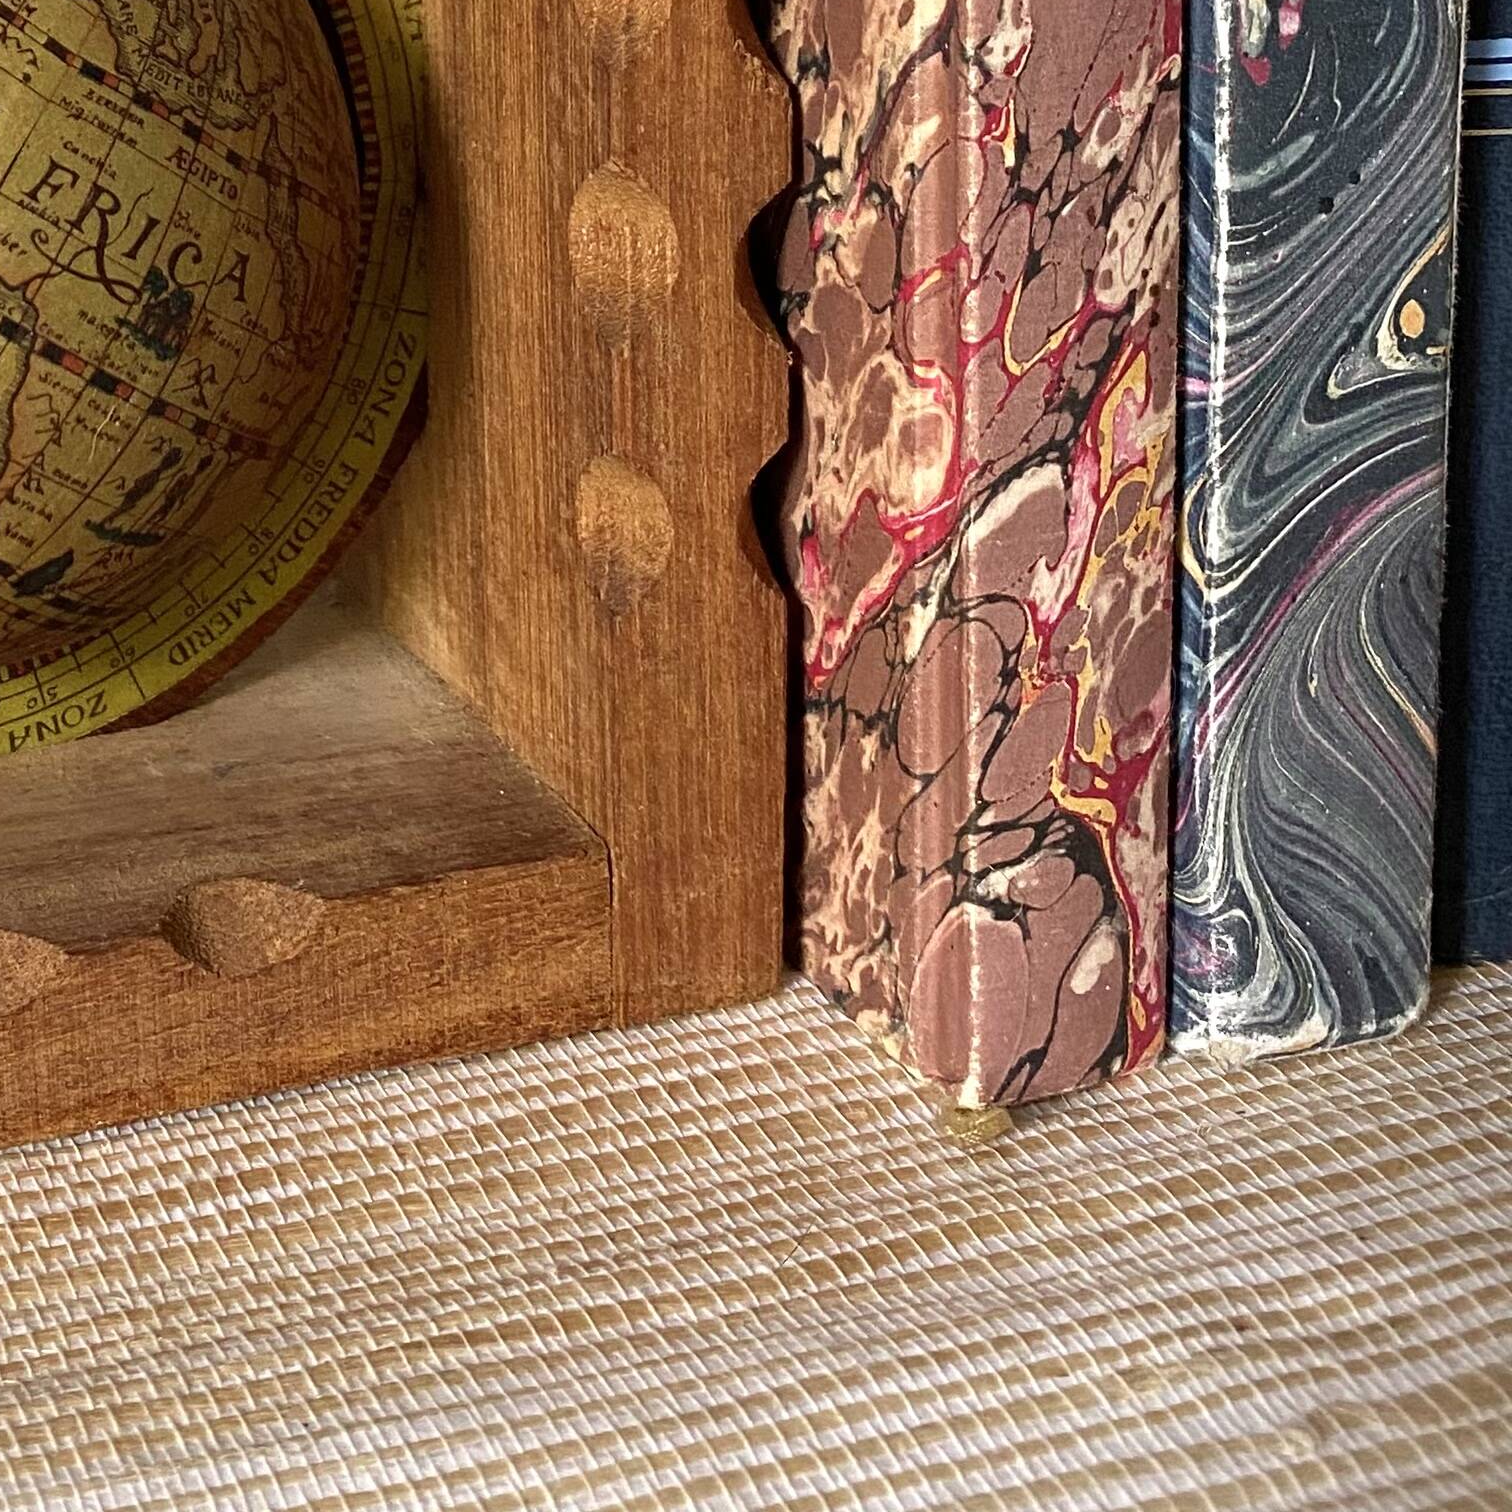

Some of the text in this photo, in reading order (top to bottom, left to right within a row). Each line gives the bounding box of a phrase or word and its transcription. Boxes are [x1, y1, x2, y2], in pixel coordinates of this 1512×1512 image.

[168, 330, 419, 666] ZONA FREDDA MERID
[10, 689, 110, 752] ZONA
